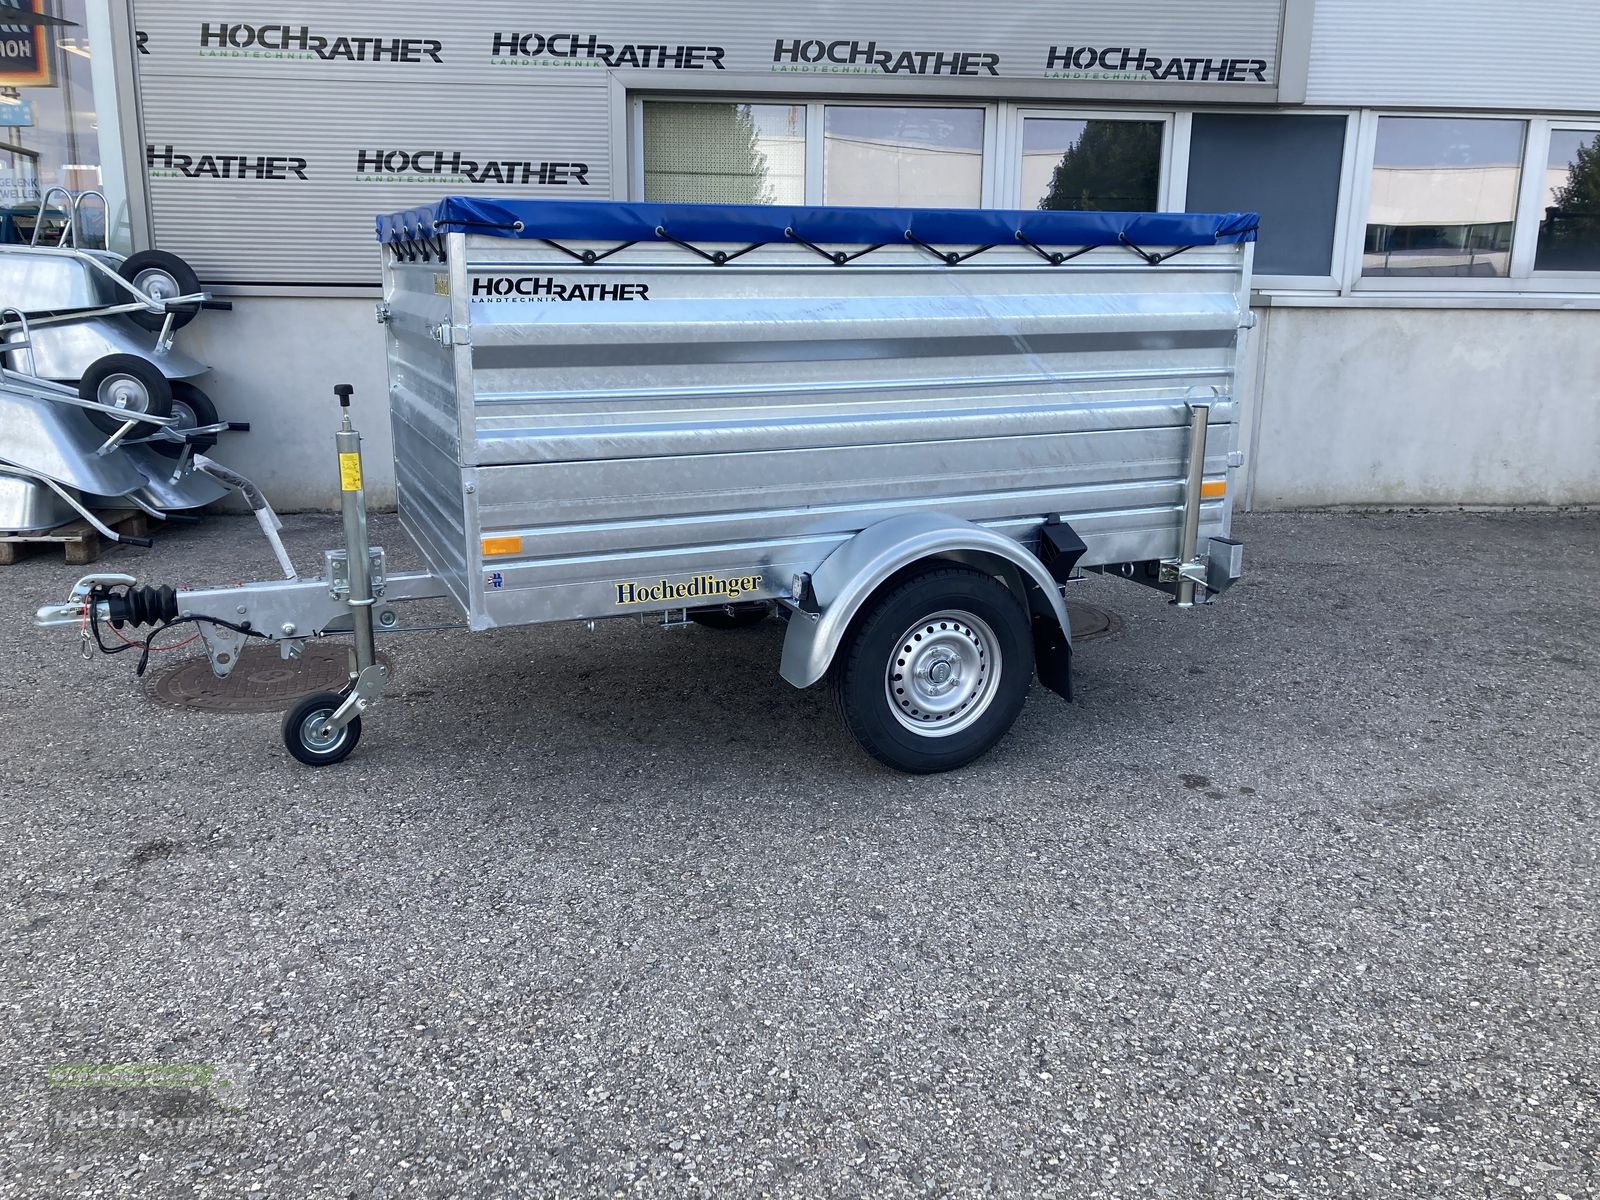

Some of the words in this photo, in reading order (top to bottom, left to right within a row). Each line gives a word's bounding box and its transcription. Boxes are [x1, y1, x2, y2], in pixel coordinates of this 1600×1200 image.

[199, 50, 314, 60] LANDTECHNIK
[201, 22, 443, 63] HOCHRATHER
[492, 32, 726, 69] HOCHRATHER
[490, 58, 600, 67] LANDTECHNIK
[771, 65, 878, 74] LANDTECHNIK
[773, 39, 1000, 75] HOCHRATHER
[1046, 46, 1268, 82] HOCHRATHER
[1043, 71, 1148, 80] LANDTECHNIK
[355, 175, 465, 184] LANDTECHNIK
[357, 149, 590, 185] HOCHRATHER
[472, 277, 650, 301] HOCHRATHER
[615, 574, 762, 606] Hochedlinger
